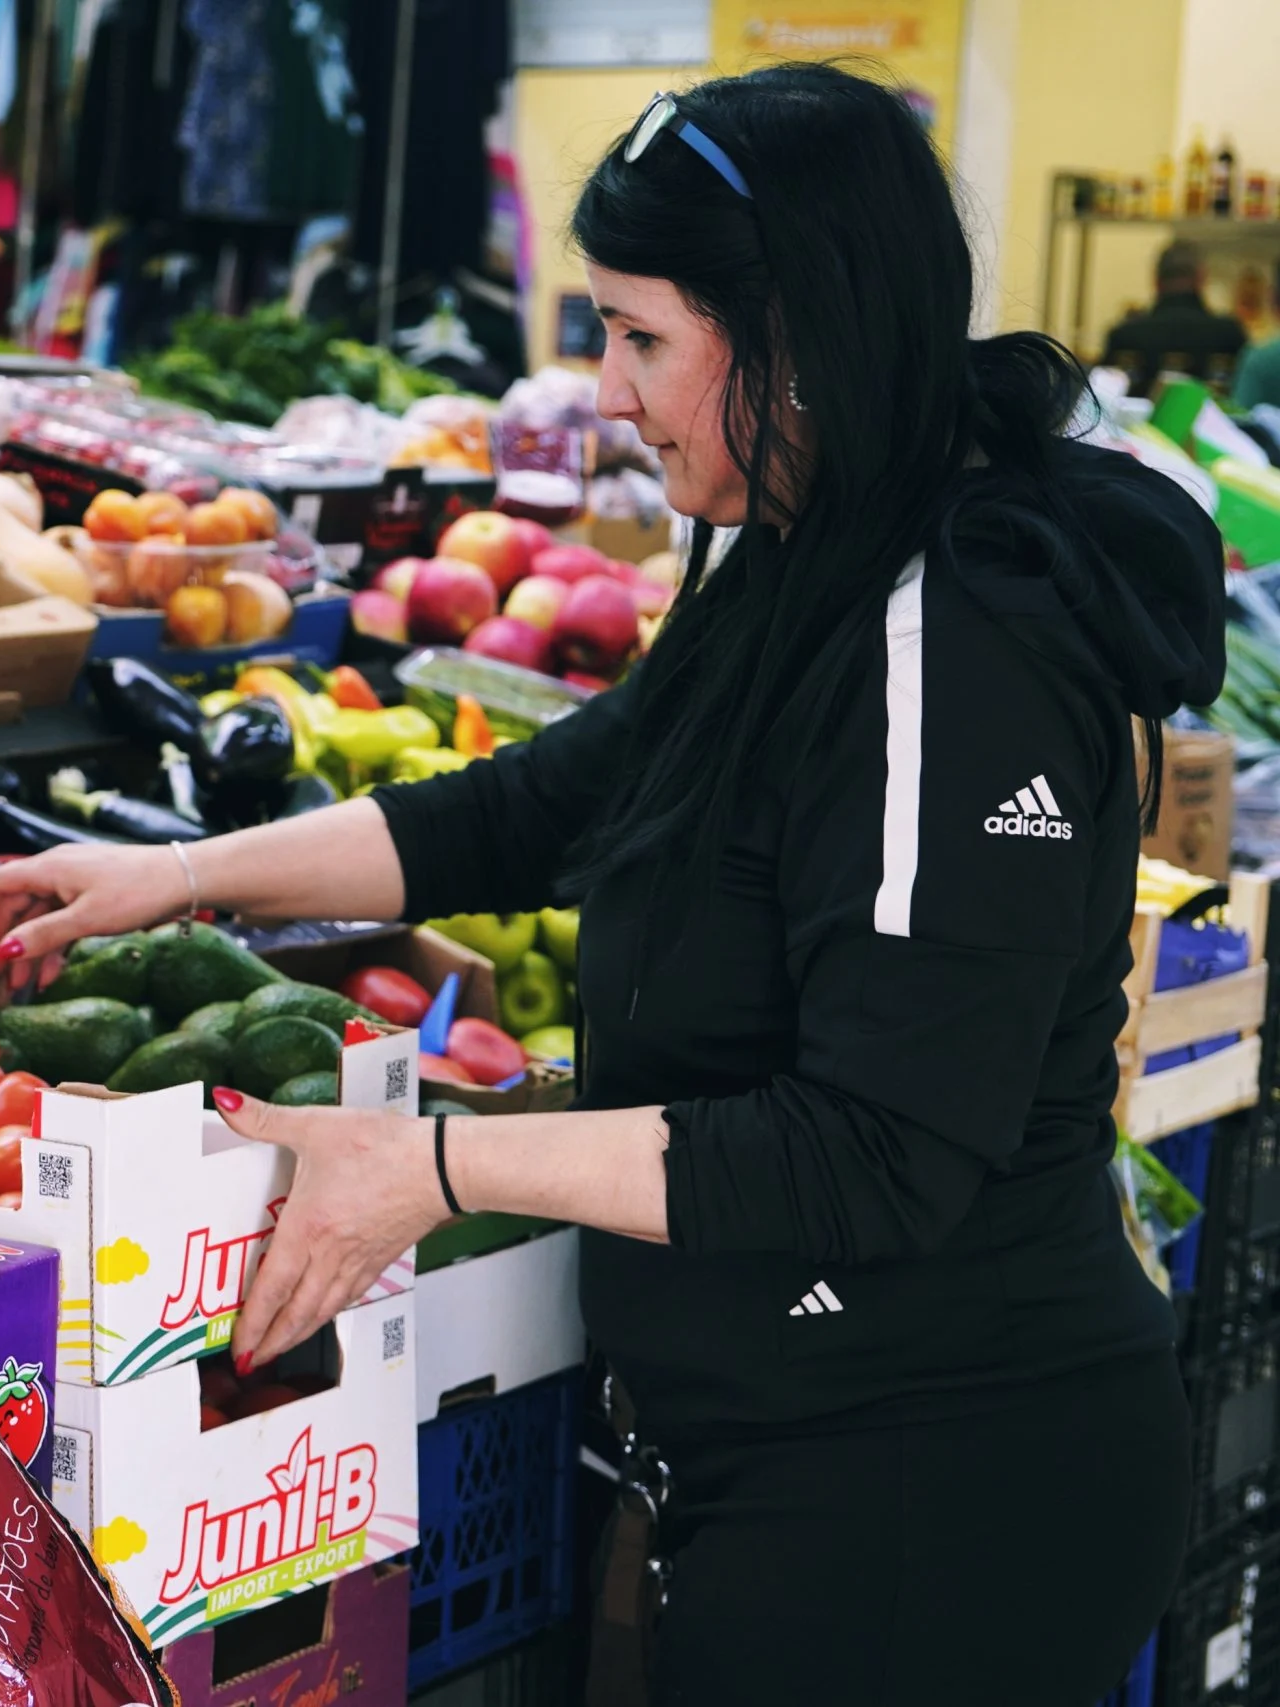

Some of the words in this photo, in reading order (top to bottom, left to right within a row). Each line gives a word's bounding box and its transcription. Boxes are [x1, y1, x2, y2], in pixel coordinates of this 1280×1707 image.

[984, 813, 1072, 840] adidas
[210, 1570, 278, 1613] IMPORT
[294, 1538, 358, 1580] EXPORT
[28, 1577, 54, 1602] de
